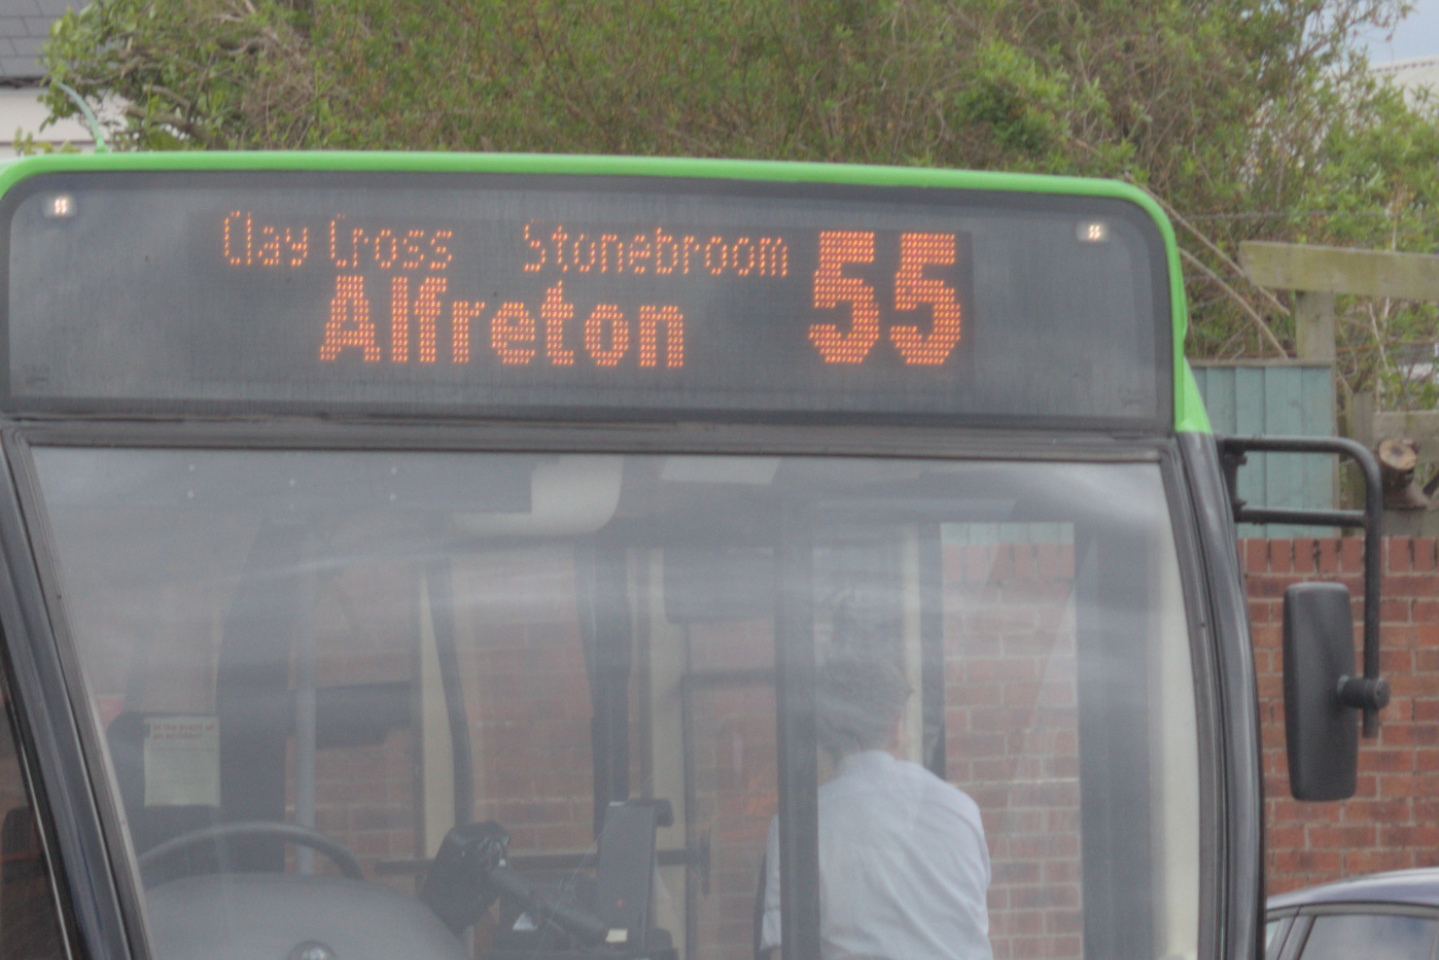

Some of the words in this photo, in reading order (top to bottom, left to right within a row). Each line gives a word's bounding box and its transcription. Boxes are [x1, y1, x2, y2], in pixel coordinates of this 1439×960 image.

[224, 209, 308, 267] Clay
[329, 212, 453, 270] Cross
[523, 216, 789, 278] Stonebroom
[319, 274, 685, 368] Alfreton
[807, 230, 962, 366] 55
